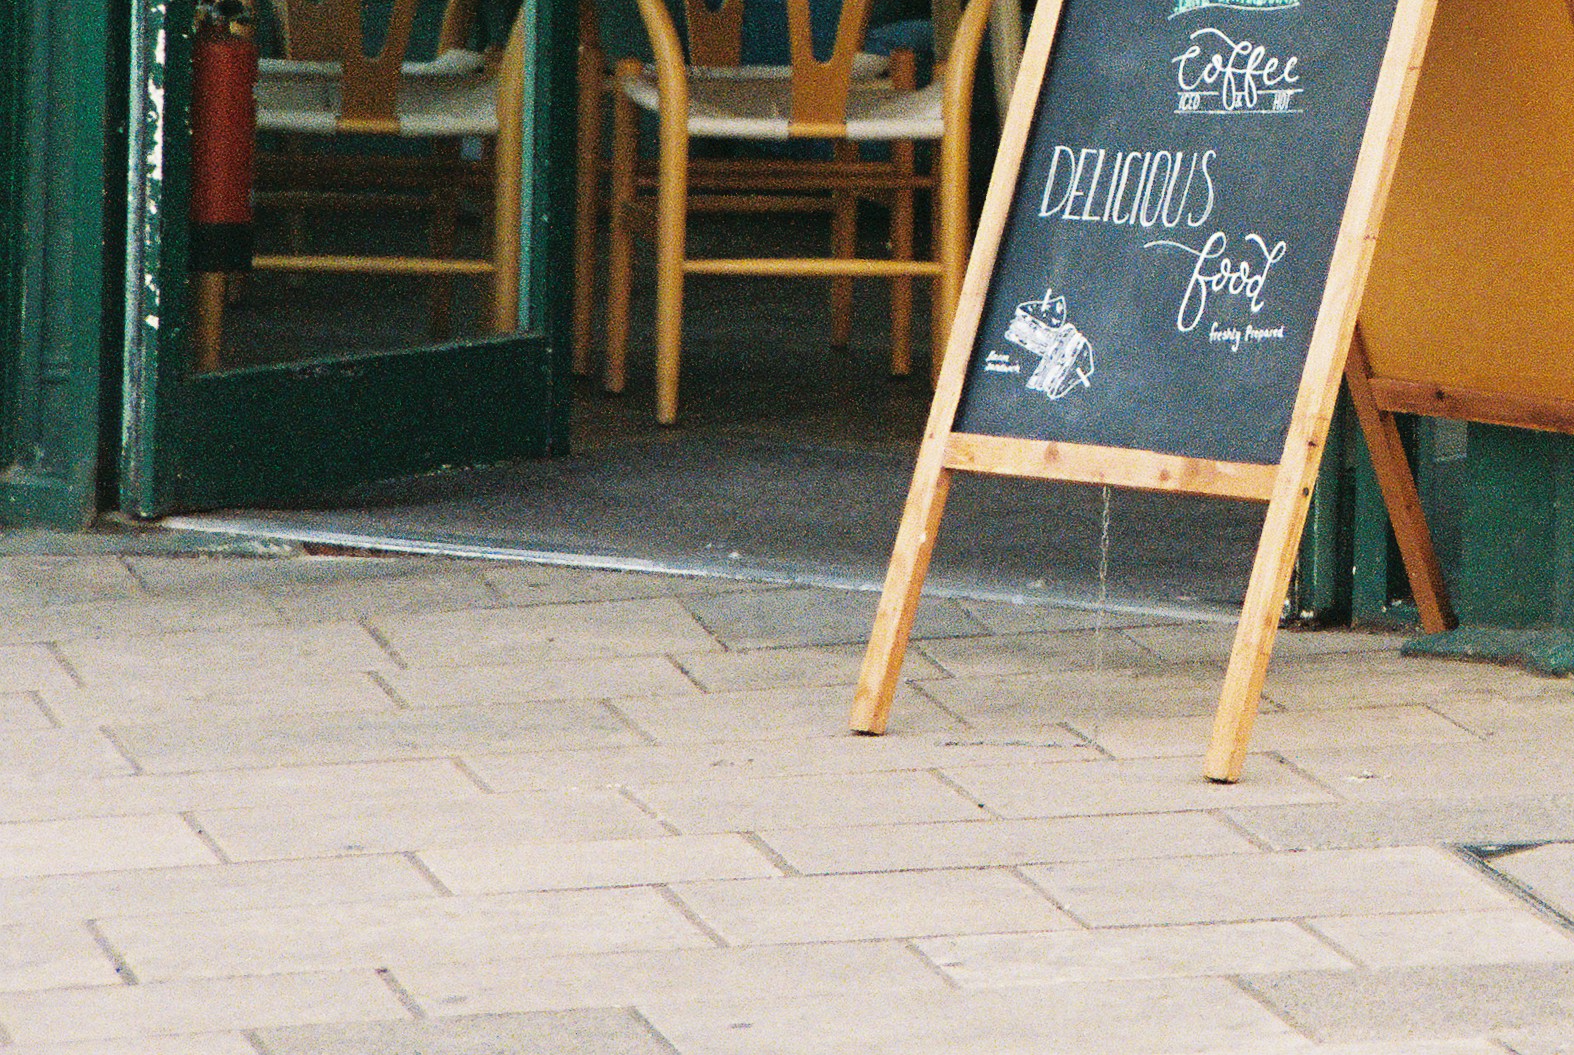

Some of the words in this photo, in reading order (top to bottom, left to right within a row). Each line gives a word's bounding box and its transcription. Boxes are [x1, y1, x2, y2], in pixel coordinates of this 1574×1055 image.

[1171, 27, 1300, 110] Coffee
[1039, 145, 1217, 227] DELICIOUS
[1143, 231, 1287, 332] food
